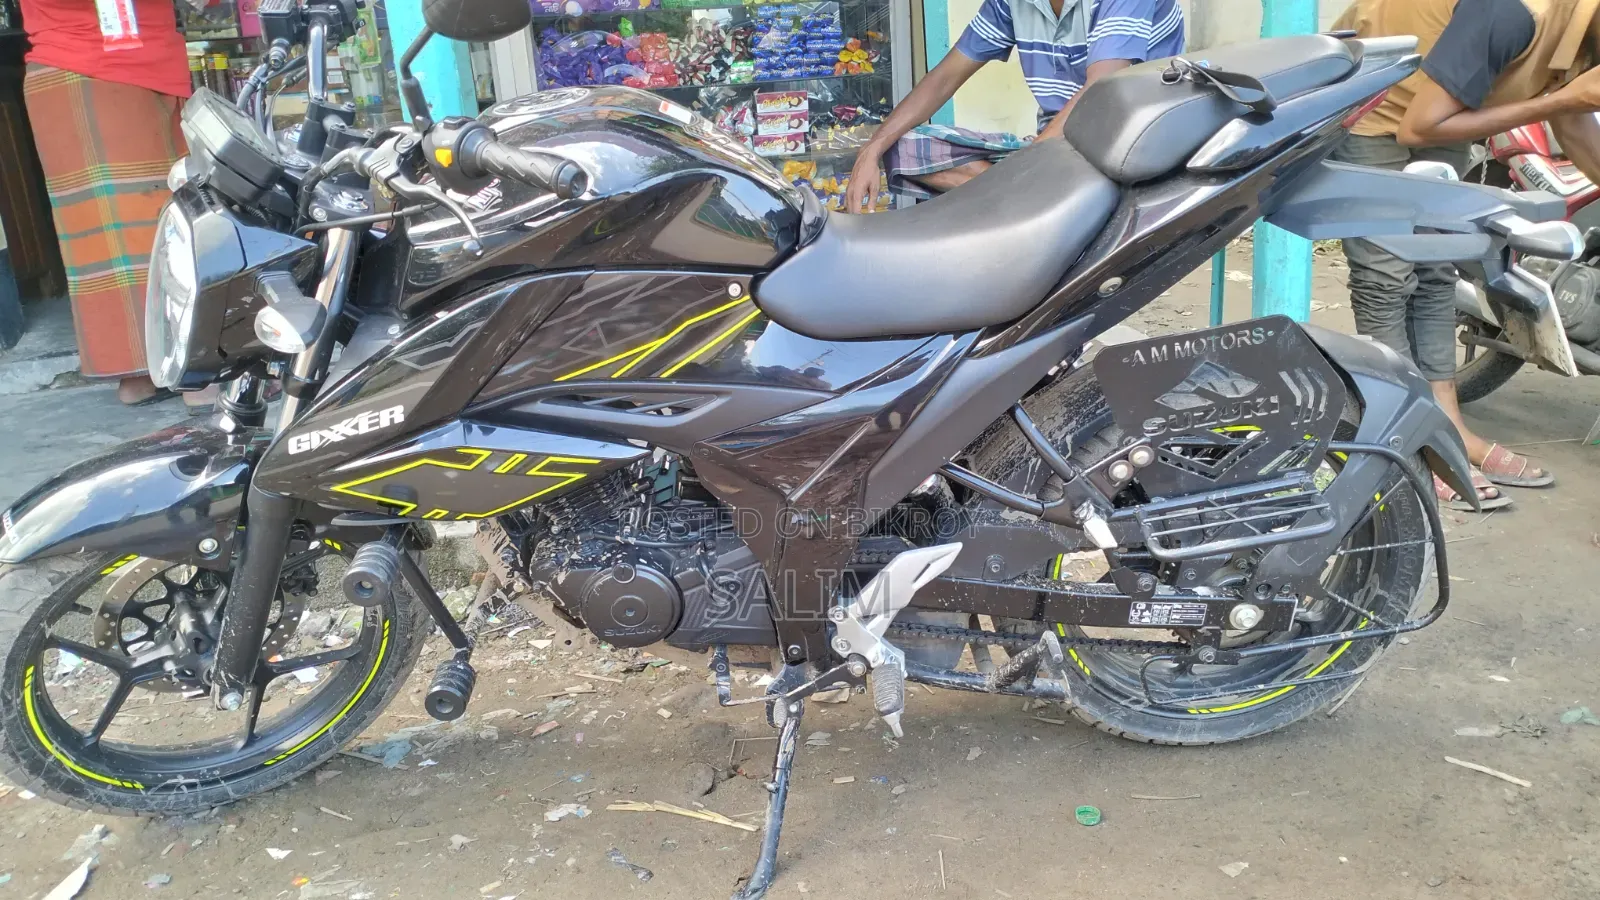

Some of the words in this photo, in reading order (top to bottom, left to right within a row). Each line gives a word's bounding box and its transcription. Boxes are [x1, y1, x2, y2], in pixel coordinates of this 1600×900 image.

[1174, 327, 1266, 360] MOTORS
[288, 404, 405, 455] GIXXER
[1142, 395, 1280, 437] SUZUKI
